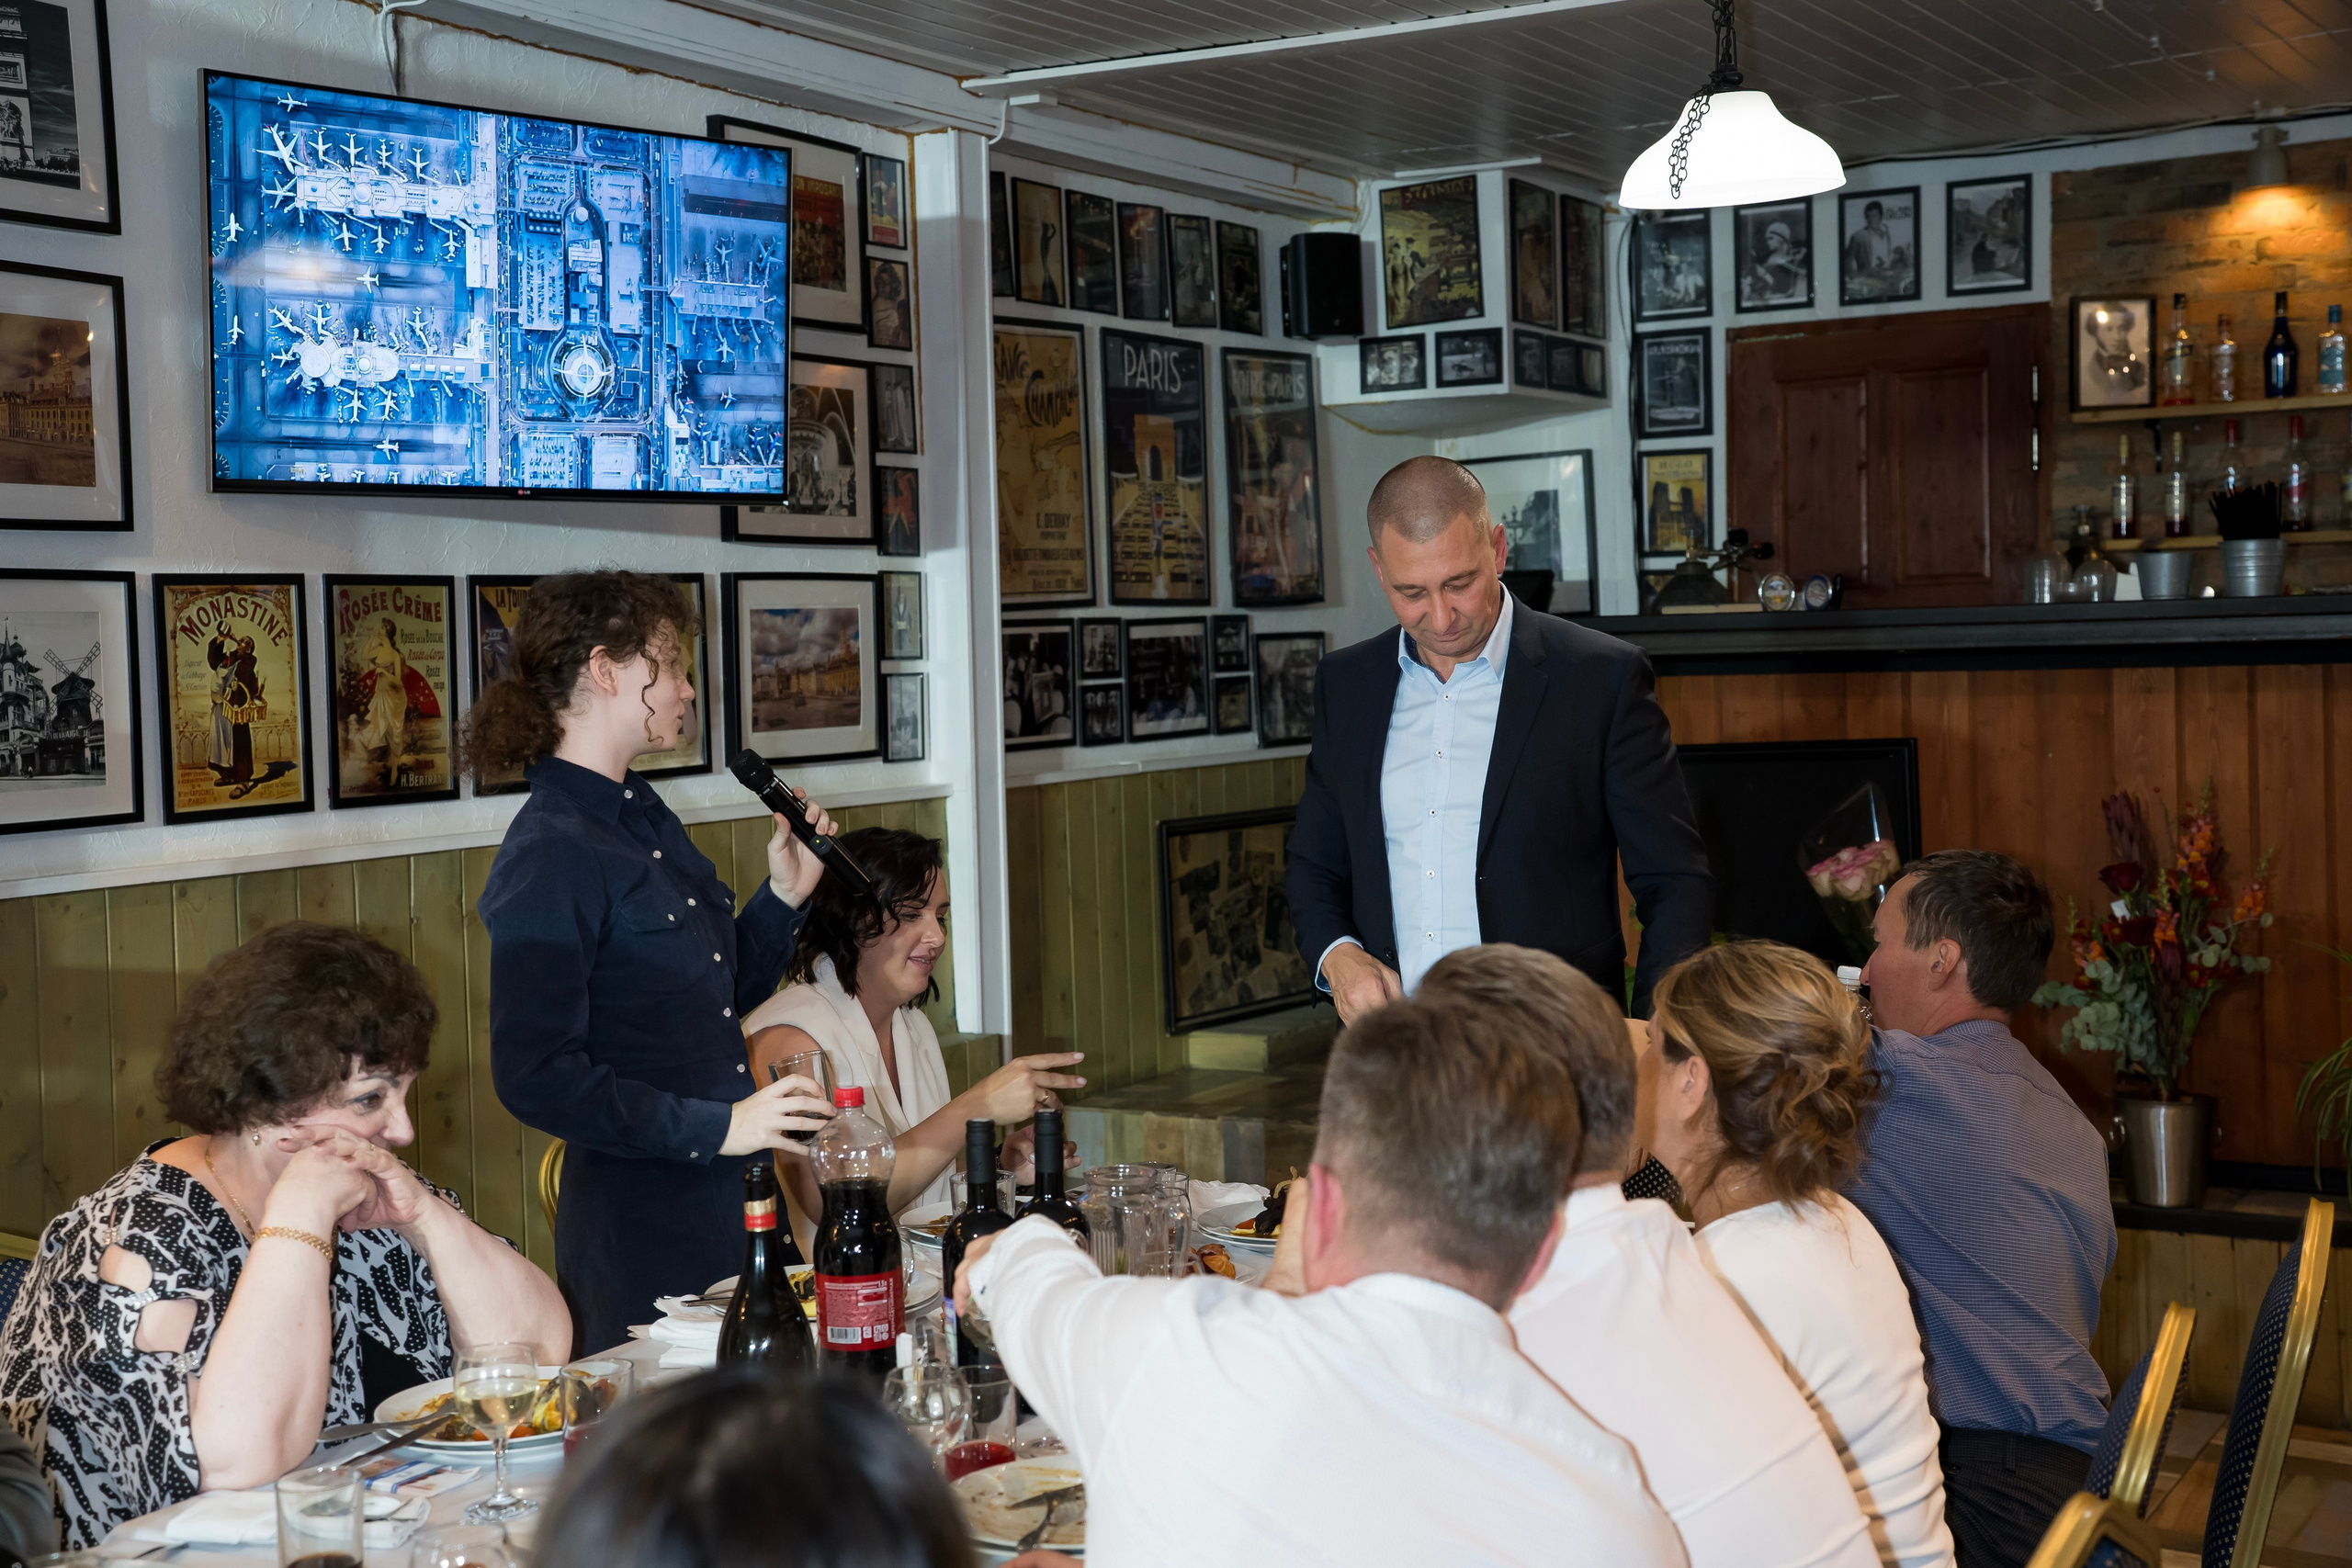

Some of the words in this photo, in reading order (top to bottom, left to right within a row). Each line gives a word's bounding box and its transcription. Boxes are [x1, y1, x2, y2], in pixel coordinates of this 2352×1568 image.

[1123, 344, 1182, 393] PARIS
[1272, 371, 1306, 400] PARIS
[179, 595, 288, 647] MONASTINE
[339, 588, 389, 636] ROSÉE
[495, 589, 506, 607] LA
